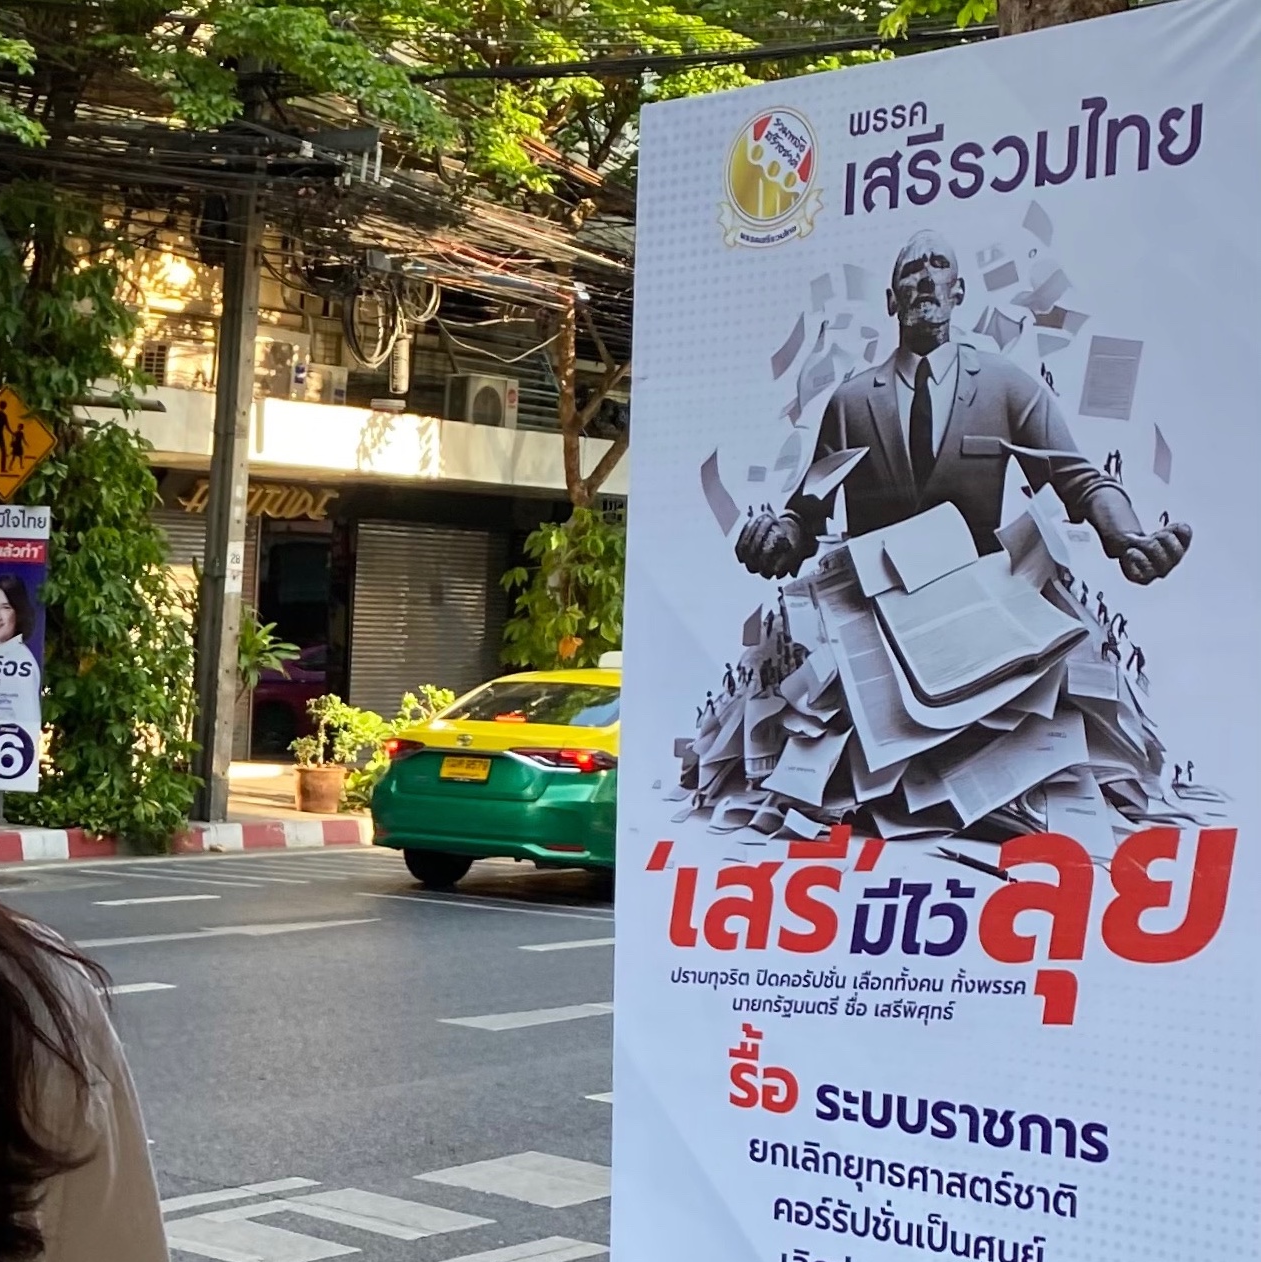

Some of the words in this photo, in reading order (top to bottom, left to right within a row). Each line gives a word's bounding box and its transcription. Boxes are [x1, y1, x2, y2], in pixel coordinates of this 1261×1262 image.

[848, 101, 928, 137] พรรค
[843, 96, 1204, 216] เสรีรวมไทย
[670, 966, 750, 991] ปราบทุจริต
[755, 965, 846, 989] ปิดคอรัปชั่น
[852, 966, 944, 993] เลือกทั้งคน
[950, 967, 1027, 996] ทั้งพรรค
[732, 994, 840, 1018] นายกรัฐมนตรี
[844, 992, 867, 1017] ชื่อ
[874, 999, 956, 1026] เสรีพิศุทธ์
[728, 1022, 800, 1114] รื้อ
[815, 1083, 1110, 1164] ระบบราชการ
[749, 1137, 1079, 1219] ยกเลิกยุทธศาสตร์ชาติ
